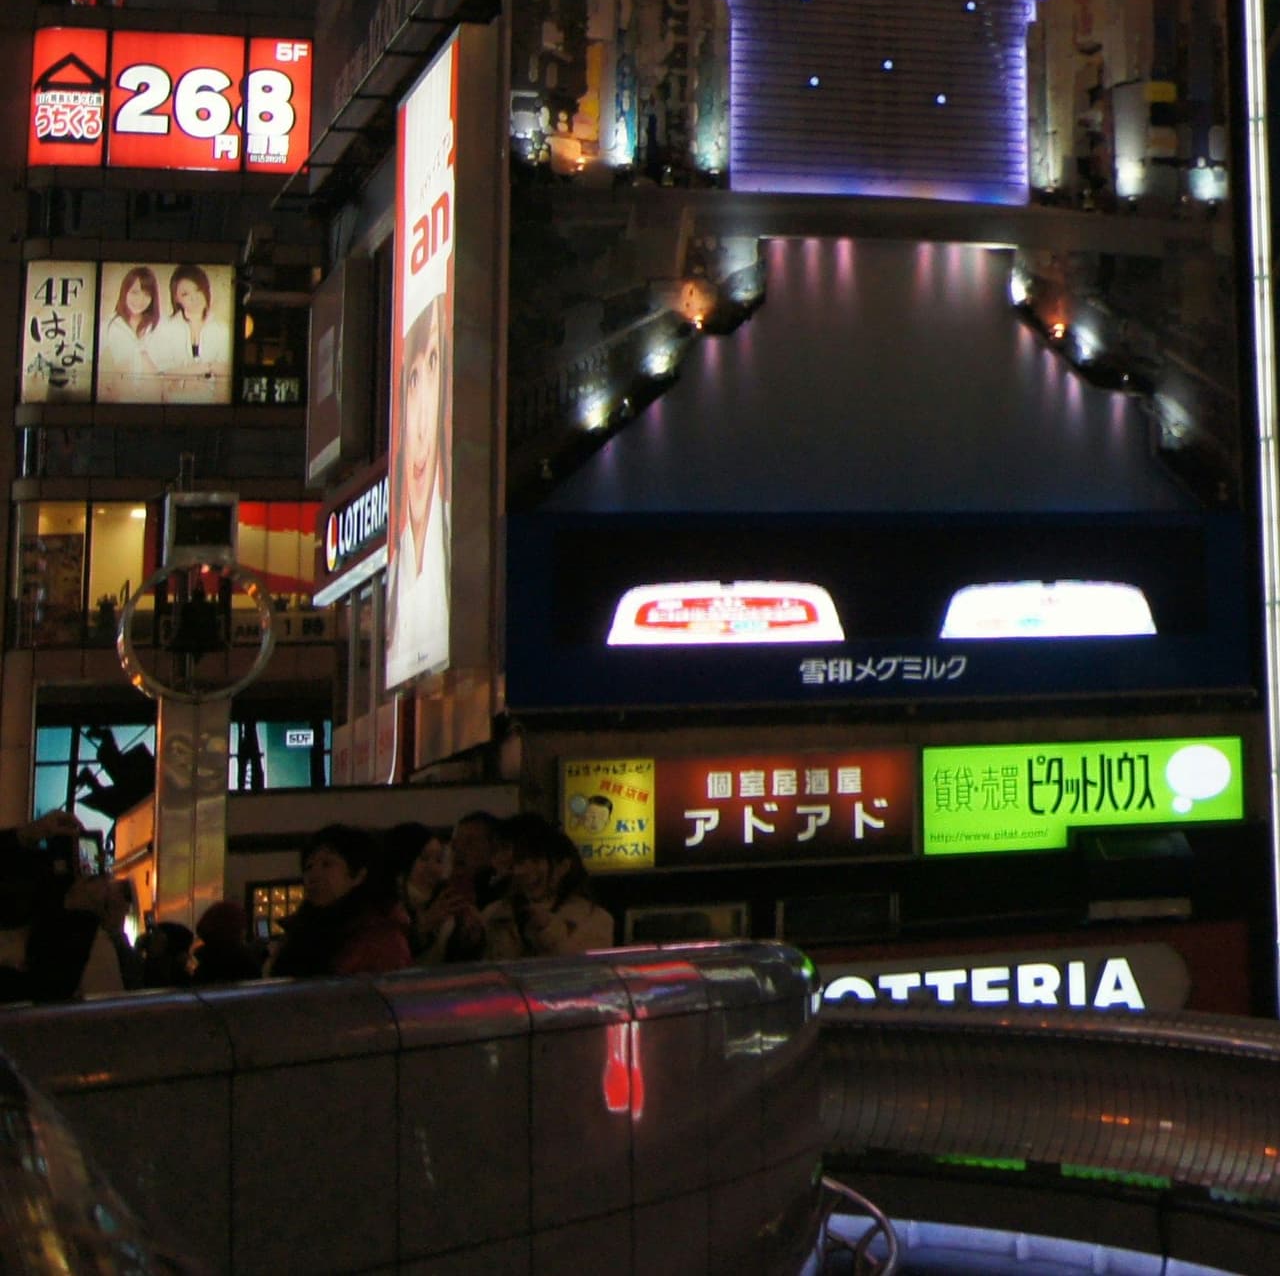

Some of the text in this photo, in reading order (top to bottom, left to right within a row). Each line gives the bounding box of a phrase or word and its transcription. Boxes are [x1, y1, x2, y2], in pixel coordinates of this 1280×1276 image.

[36, 104, 103, 140] うちくる
[114, 62, 297, 139] 268
[410, 190, 449, 276] an
[34, 276, 84, 307] 4F
[339, 476, 389, 556] LOTTERIA
[800, 655, 967, 685] 雪印メグミルク
[706, 765, 864, 799] 個室居酒屋
[933, 765, 1020, 813] 賃貸・売買
[1027, 751, 1156, 815] ピタットハウス
[684, 796, 885, 847] アドアド
[818, 955, 1147, 1010] TTERIA
